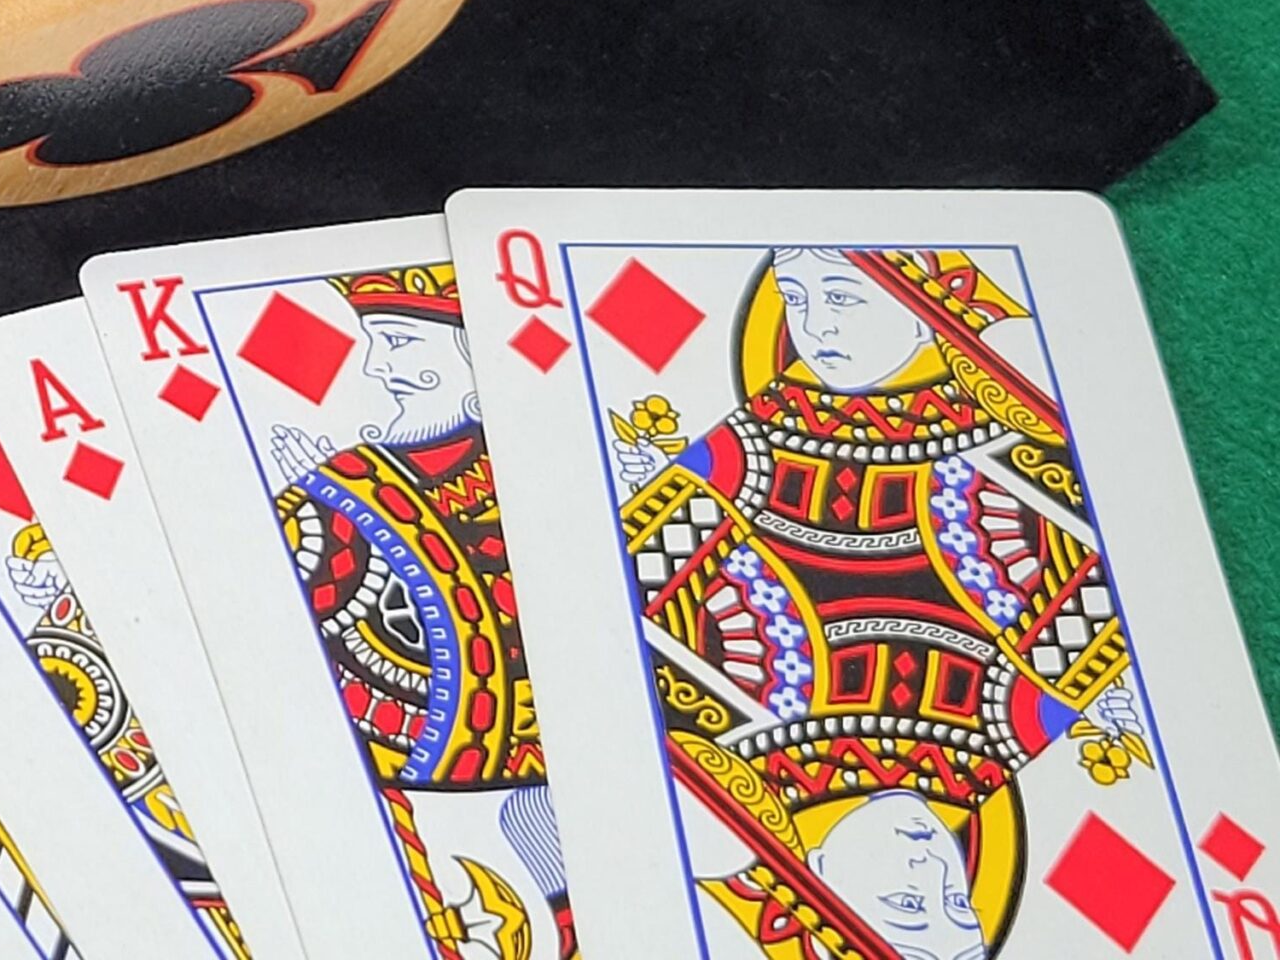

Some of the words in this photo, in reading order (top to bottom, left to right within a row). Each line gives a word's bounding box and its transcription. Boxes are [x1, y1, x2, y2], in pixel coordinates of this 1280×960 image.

[494, 227, 565, 309] Q
[116, 275, 210, 361] K
[30, 358, 106, 442] A
